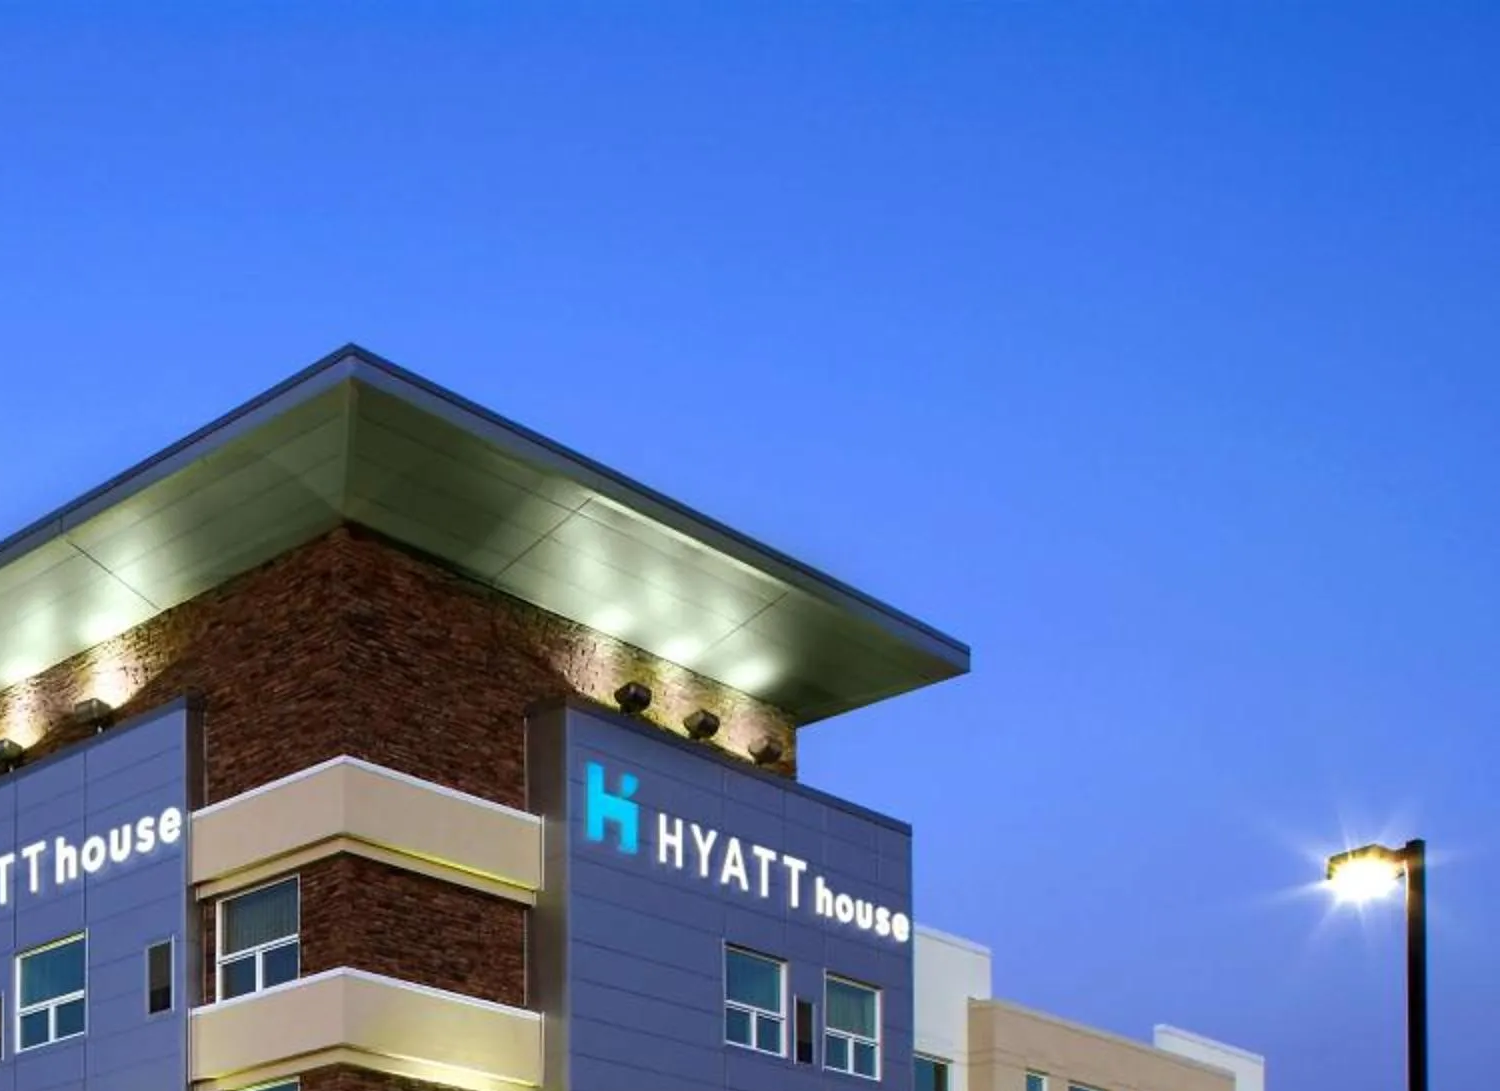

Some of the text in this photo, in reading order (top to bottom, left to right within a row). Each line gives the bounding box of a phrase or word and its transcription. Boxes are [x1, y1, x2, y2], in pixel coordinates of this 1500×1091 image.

[55, 806, 182, 885] house
[657, 812, 910, 943] HYATT house
